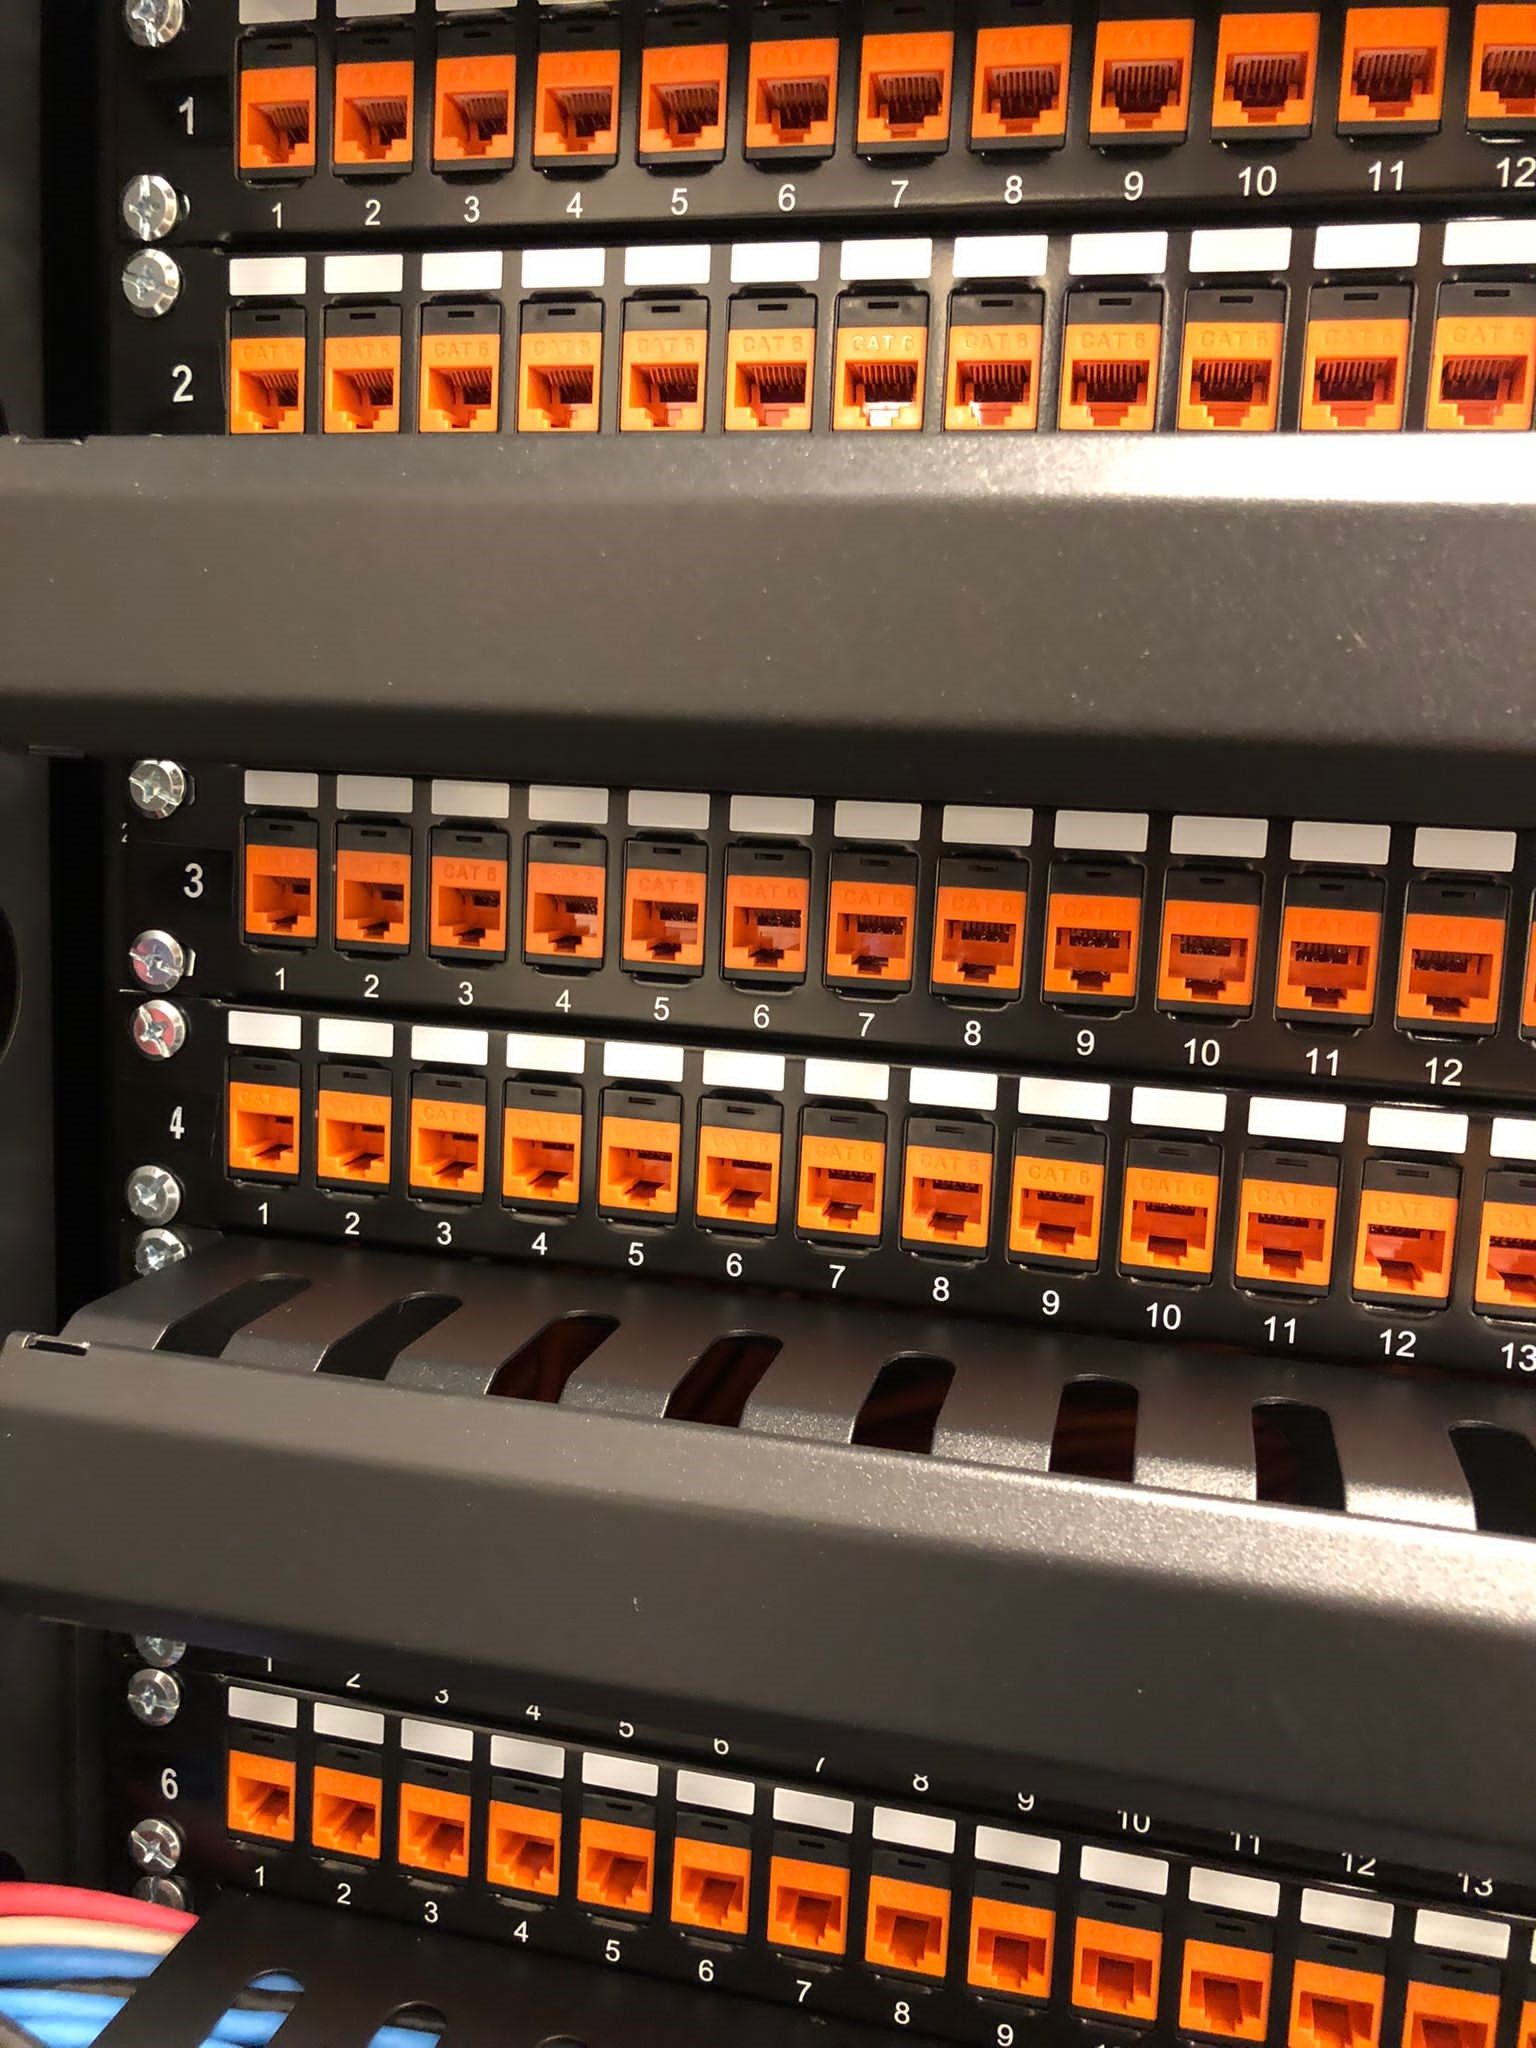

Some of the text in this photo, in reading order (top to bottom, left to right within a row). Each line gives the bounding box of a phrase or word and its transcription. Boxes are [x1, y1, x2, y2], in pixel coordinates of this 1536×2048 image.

[178, 96, 194, 135] 1
[1238, 165, 1277, 197] 10
[1368, 160, 1404, 192] 11
[1496, 156, 1536, 188] 12
[778, 183, 796, 212] 6
[891, 179, 909, 208] 7
[1003, 174, 1023, 204] 8
[1123, 170, 1144, 201] 9
[364, 199, 381, 226] 2
[463, 195, 481, 223] 3
[565, 191, 584, 219] 4
[670, 187, 689, 216] 5
[271, 202, 282, 229] 1
[637, 336, 680, 354] CAT
[742, 335, 785, 353] CAT
[851, 333, 896, 352] CAT
[963, 332, 1011, 351] CAT
[1080, 331, 1128, 351] CAT
[1200, 330, 1249, 350] CAT
[1452, 325, 1505, 346] CAT
[434, 341, 489, 358] CAT 6
[172, 364, 194, 403] 2
[183, 862, 204, 899] 3
[443, 862, 497, 882] CAT 6
[638, 876, 682, 894] CAT
[738, 881, 782, 900] CAT
[275, 967, 285, 991] 1
[363, 974, 380, 999] 2
[458, 981, 474, 1006] 3
[555, 989, 572, 1013] 4
[653, 996, 670, 1021] 5
[753, 1003, 770, 1029] 6
[858, 1012, 876, 1037] 7
[963, 1020, 982, 1046] 8
[1076, 1029, 1095, 1056] 9
[1184, 1038, 1220, 1066] 10
[1305, 1047, 1339, 1077] 11
[1425, 1056, 1463, 1087] 12
[169, 1105, 185, 1140] 4
[423, 1106, 460, 1122] CAT
[814, 1143, 873, 1162] CAT 6
[920, 1152, 981, 1174] CAT 6
[1027, 1164, 1091, 1185] CAT 6
[1139, 1174, 1185, 1196] CAT
[258, 1202, 268, 1225] 1
[344, 1211, 360, 1236] 2
[436, 1221, 452, 1246] 3
[531, 1231, 548, 1256] 4
[628, 1241, 644, 1266] 5
[726, 1252, 743, 1277] 6
[829, 1264, 846, 1289] 7
[932, 1276, 950, 1302] 8
[1042, 1289, 1060, 1316] 9
[1146, 1302, 1182, 1330] 10
[1263, 1315, 1296, 1344] 11
[1379, 1328, 1417, 1358] 12
[1501, 1342, 1536, 1372] 13
[525, 1704, 542, 1721] 4
[713, 1738, 729, 1755] 6
[161, 1767, 179, 1800] 6
[912, 1773, 929, 1792] 8
[1017, 1792, 1035, 1811] 9
[1117, 1810, 1151, 1833] 10
[1231, 1832, 1260, 1855] 11
[255, 1865, 264, 1887] 1
[1342, 1852, 1376, 1877] 12
[336, 1882, 351, 1905] 2
[1458, 1873, 1493, 1897] 13
[424, 1901, 439, 1924] 3
[513, 1920, 529, 1943] 4
[605, 1939, 621, 1962] 5
[698, 1959, 714, 1982] 6
[796, 1979, 812, 2003] 7
[894, 2001, 910, 2025] 8
[996, 2023, 1014, 2047] 9
